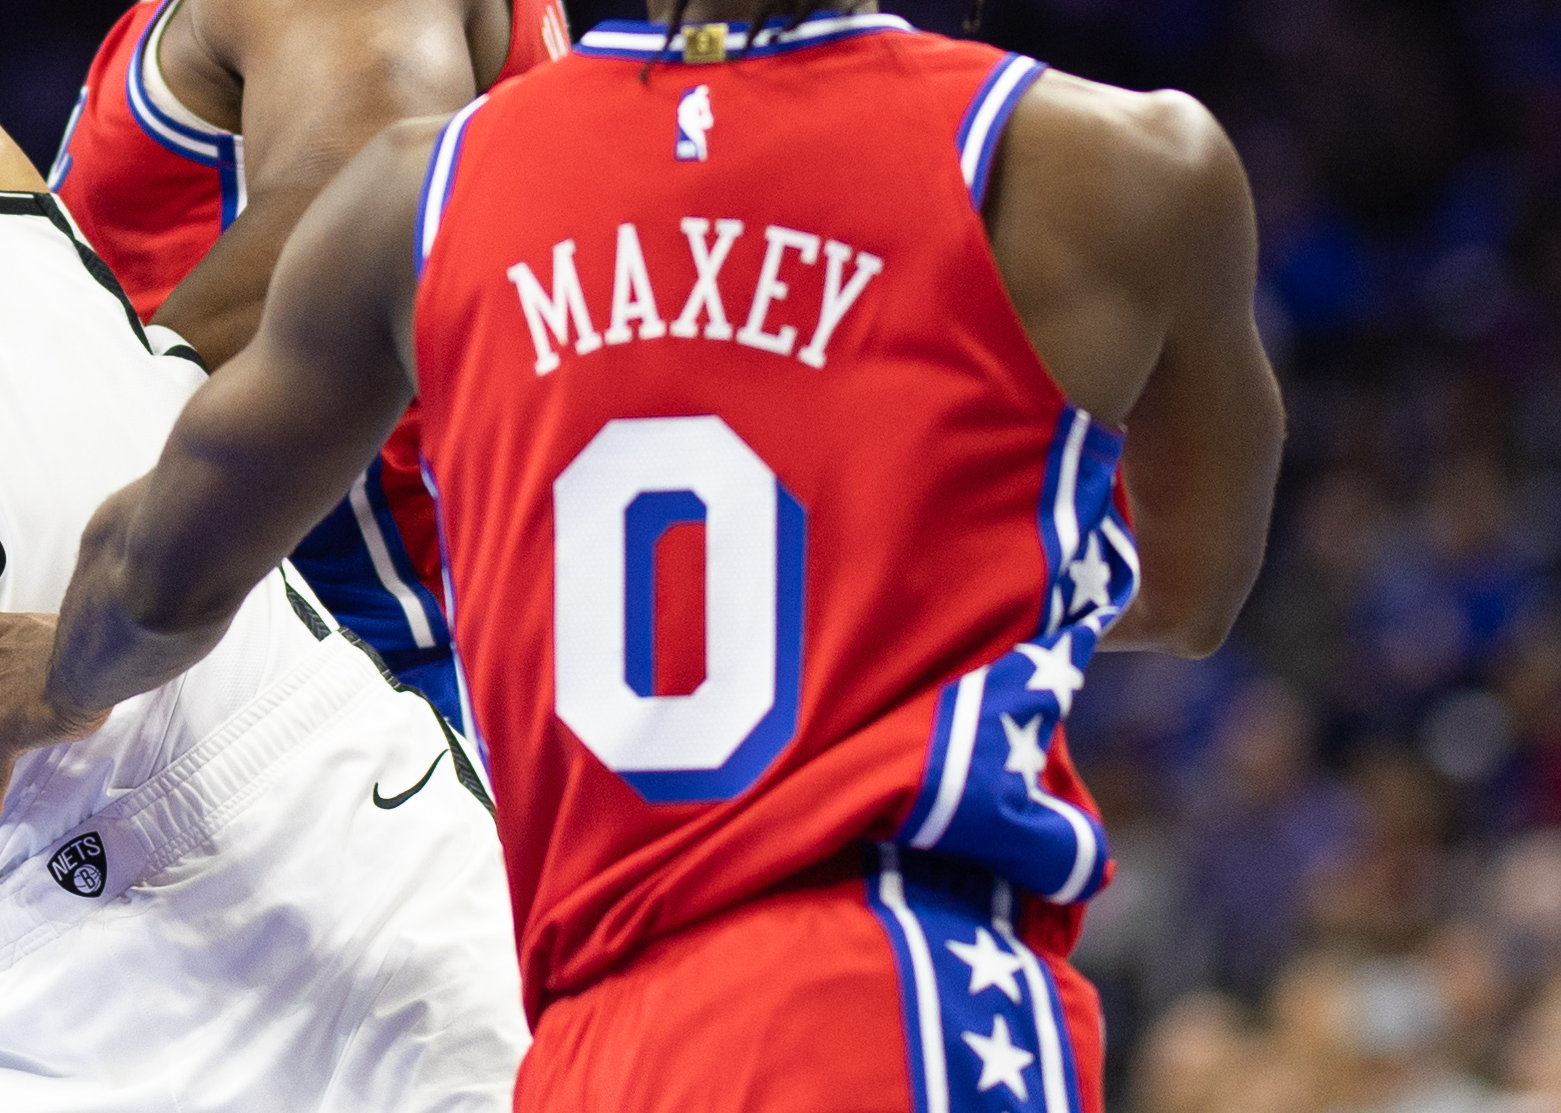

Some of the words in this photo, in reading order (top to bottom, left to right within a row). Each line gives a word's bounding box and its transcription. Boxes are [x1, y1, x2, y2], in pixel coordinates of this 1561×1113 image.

[506, 216, 883, 377] MAXEY
[553, 414, 806, 802] 0
[52, 836, 101, 881] NETS
[79, 868, 96, 889] B
